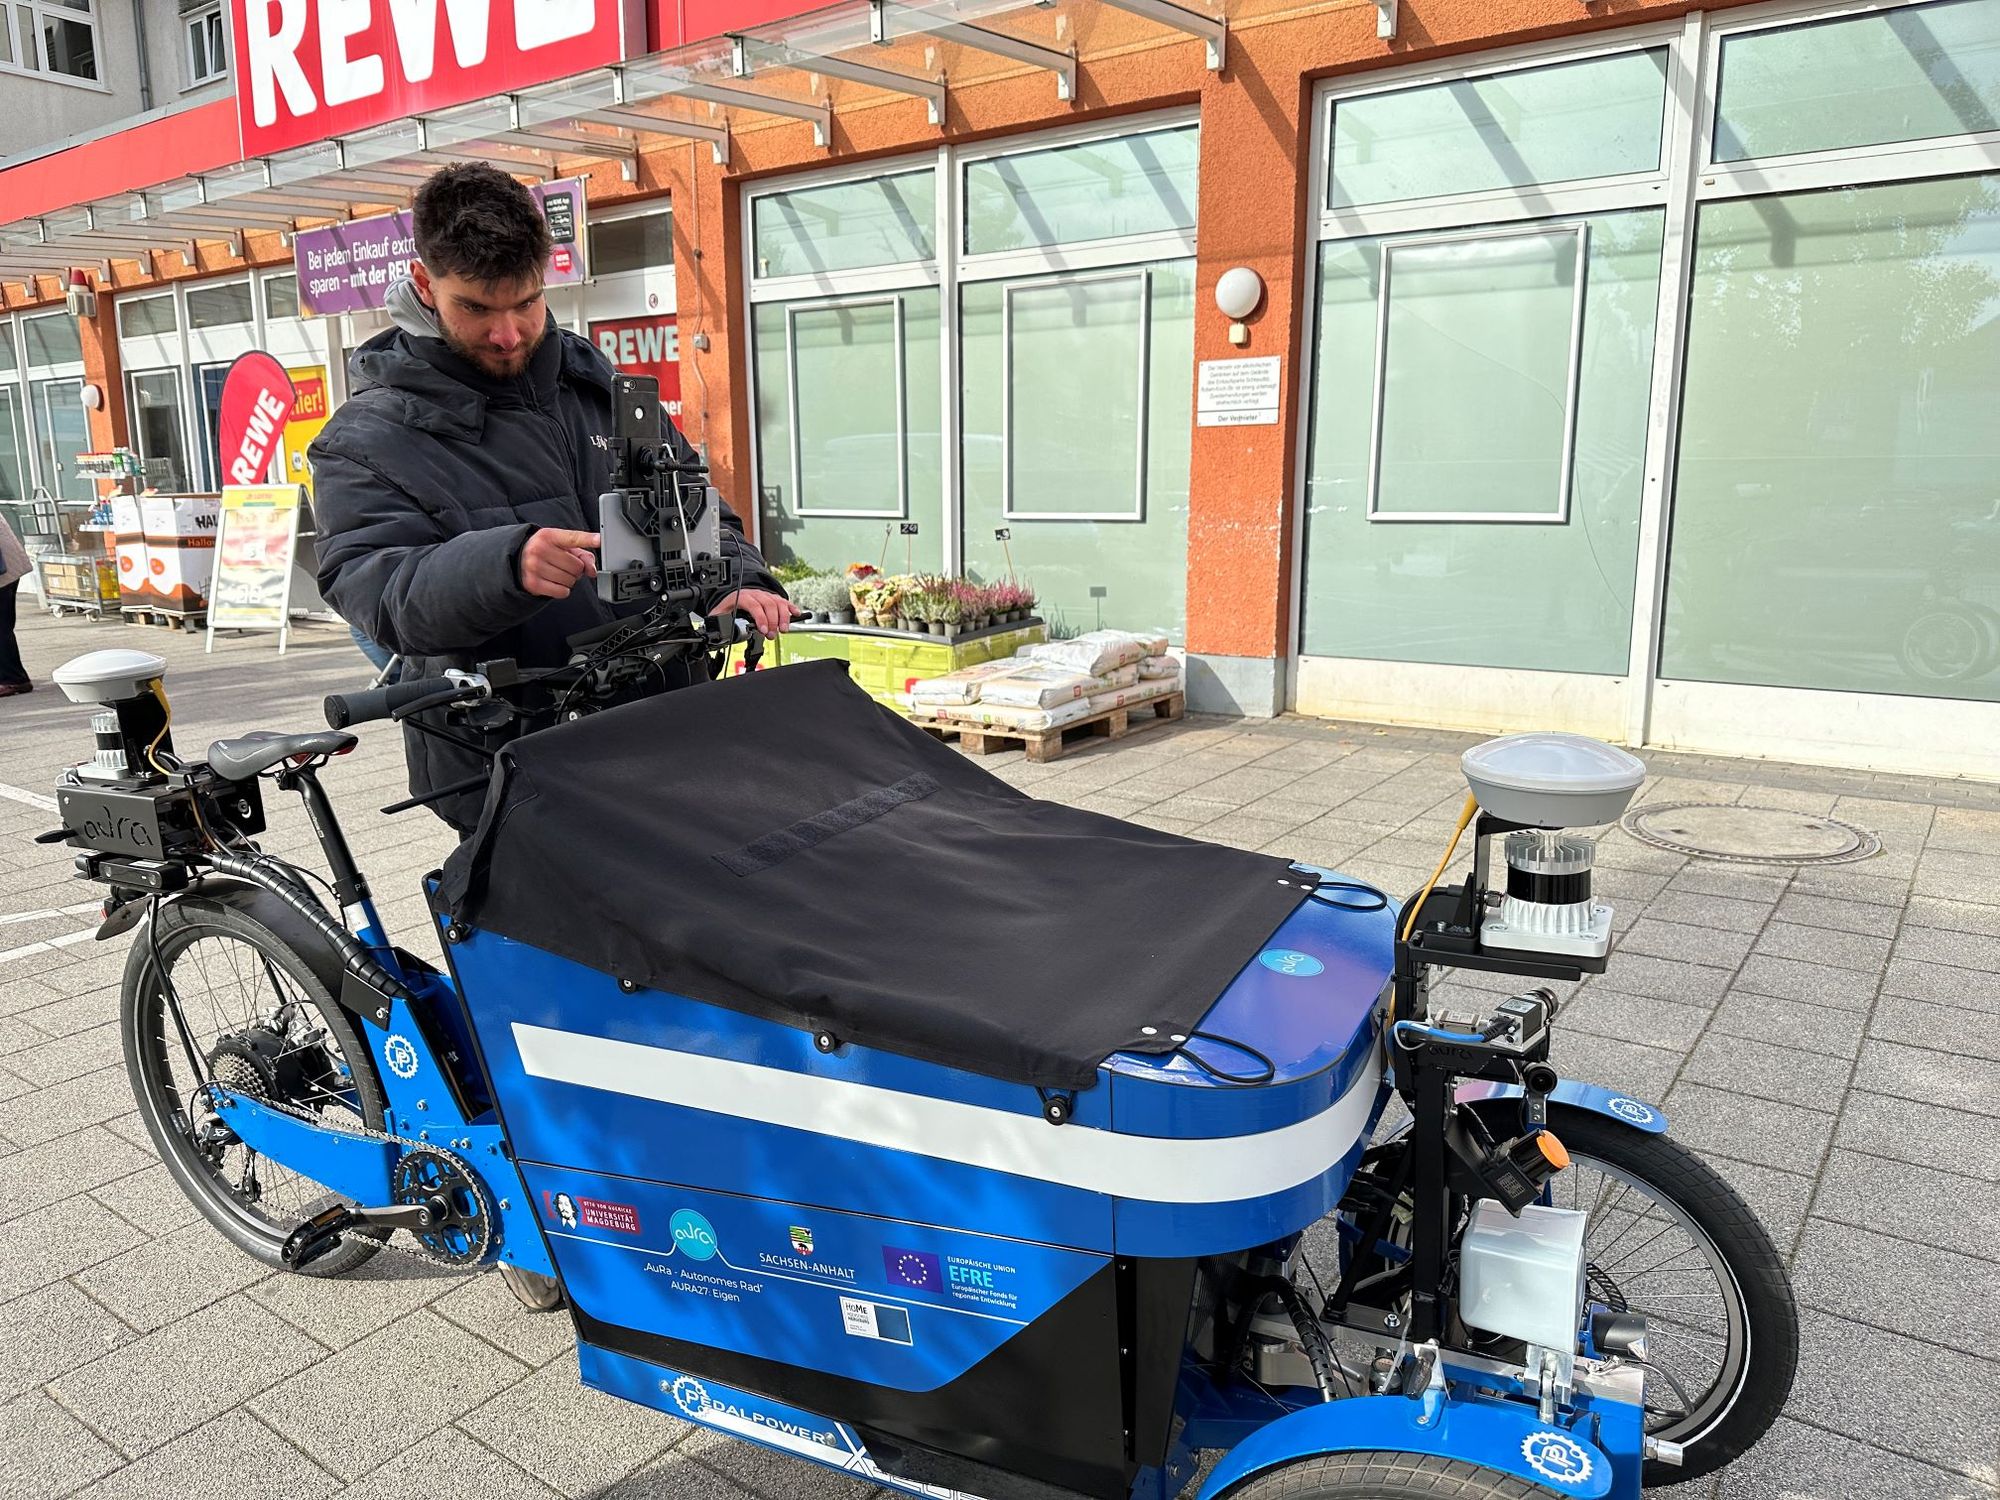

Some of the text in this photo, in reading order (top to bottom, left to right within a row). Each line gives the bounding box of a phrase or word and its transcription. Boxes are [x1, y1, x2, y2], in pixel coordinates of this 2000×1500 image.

[307, 250, 322, 270] Bei
[324, 247, 351, 272] jedem
[353, 236, 390, 262] Einkauf
[309, 276, 341, 298] sparen
[350, 267, 368, 288] mit
[368, 265, 387, 285] der
[600, 326, 681, 365] REWE
[231, 388, 286, 484] REWE
[84, 805, 154, 846] aura
[587, 1216, 636, 1231] MAGDEBURG
[675, 1222, 714, 1245] aura
[759, 1252, 855, 1280] SACHSEN-ANHALT
[949, 1265, 994, 1289] EFRE
[993, 1262, 1016, 1274] UNION
[680, 1269, 738, 1289] Autonomes
[713, 1288, 740, 1302] Eigen
[952, 1292, 1017, 1309] regionale Entwicklung
[990, 1290, 1008, 1299] Fonds
[1008, 1293, 1018, 1301] für
[685, 1388, 826, 1444] PEDALPOWER
